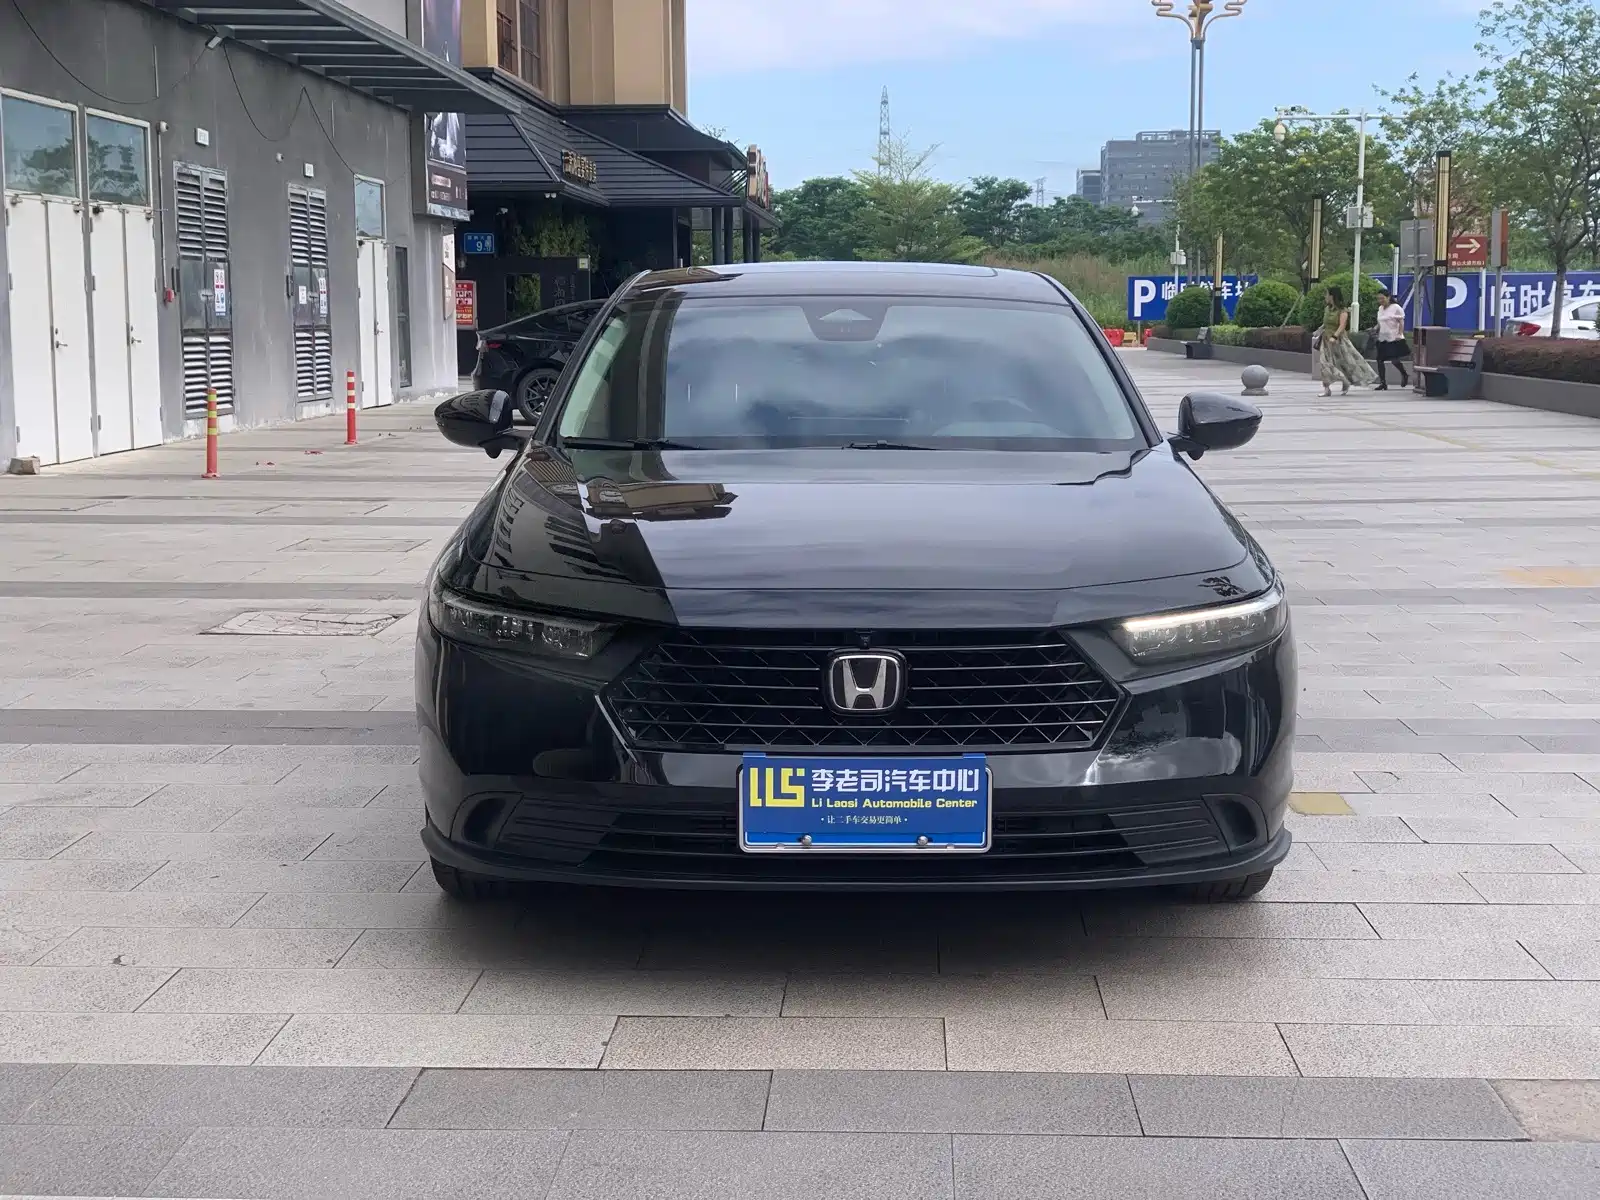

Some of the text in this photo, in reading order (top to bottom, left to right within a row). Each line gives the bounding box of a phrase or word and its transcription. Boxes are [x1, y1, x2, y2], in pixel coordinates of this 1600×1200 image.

[1133, 279, 1157, 317] P
[811, 768, 980, 793] 李老司汽车中心
[811, 798, 978, 808] Li Laosi Automobile Center
[826, 815, 902, 825] 让二手车交易更简单
